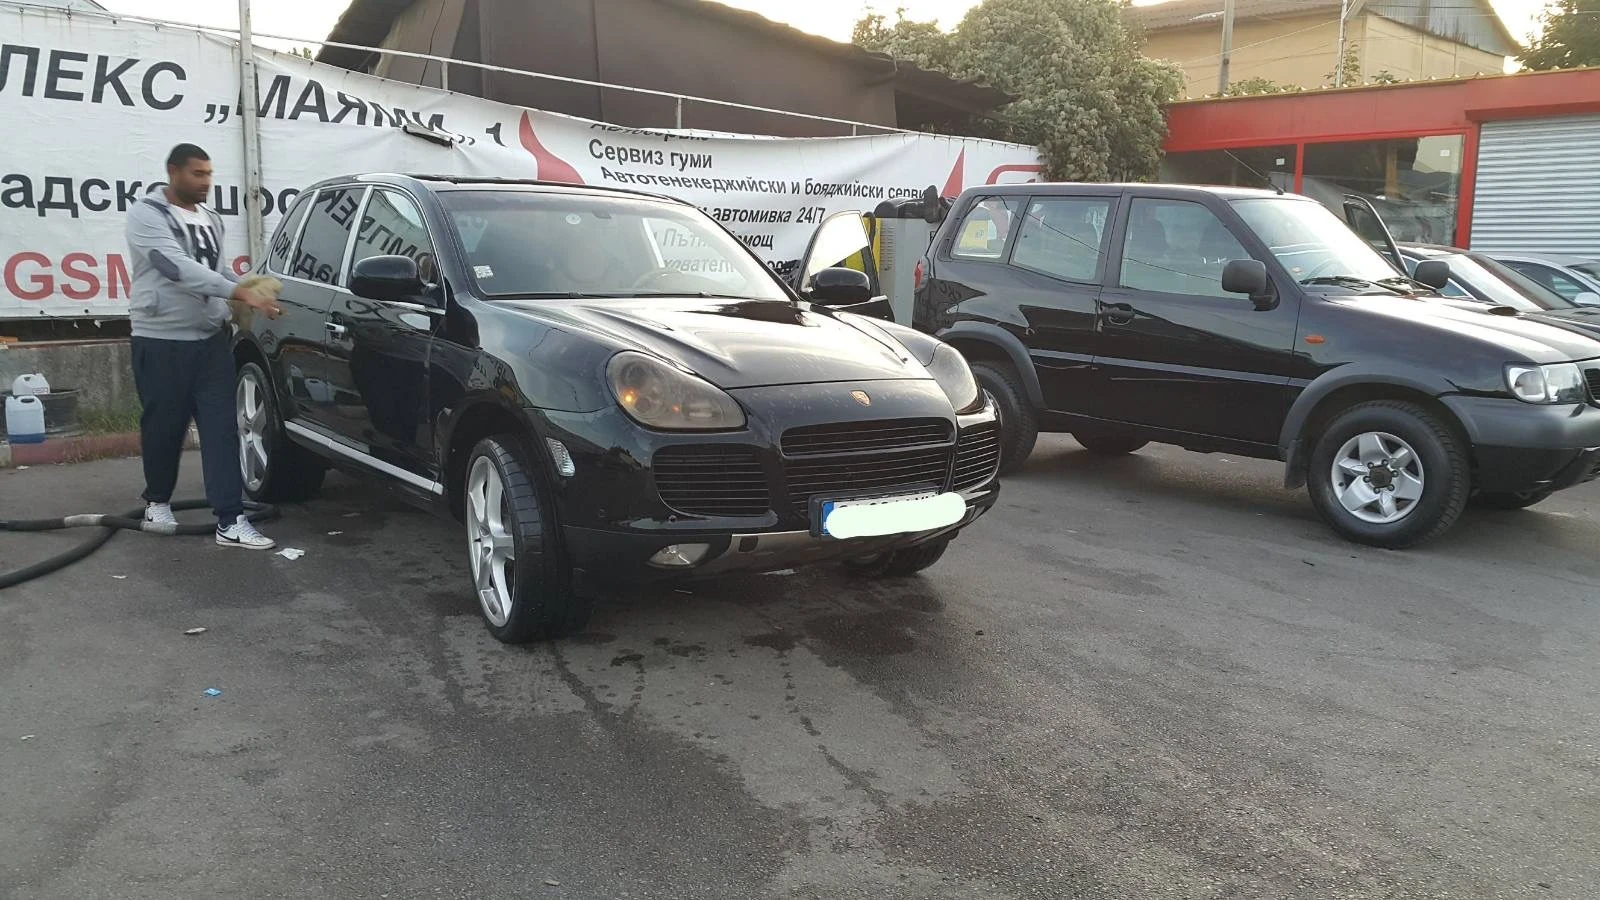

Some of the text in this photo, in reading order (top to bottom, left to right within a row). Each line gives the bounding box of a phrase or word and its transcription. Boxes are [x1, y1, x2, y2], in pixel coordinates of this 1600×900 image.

[0, 44, 187, 110] ЛЕКС
[588, 138, 713, 171] Сервиз гуми
[1, 173, 169, 218] адск
[600, 166, 787, 194] Автотенекеджийски
[791, 180, 801, 195] и
[805, 178, 884, 198] бояджийски
[713, 206, 826, 224] автомивка 24/7
[4, 252, 131, 300] GSM
